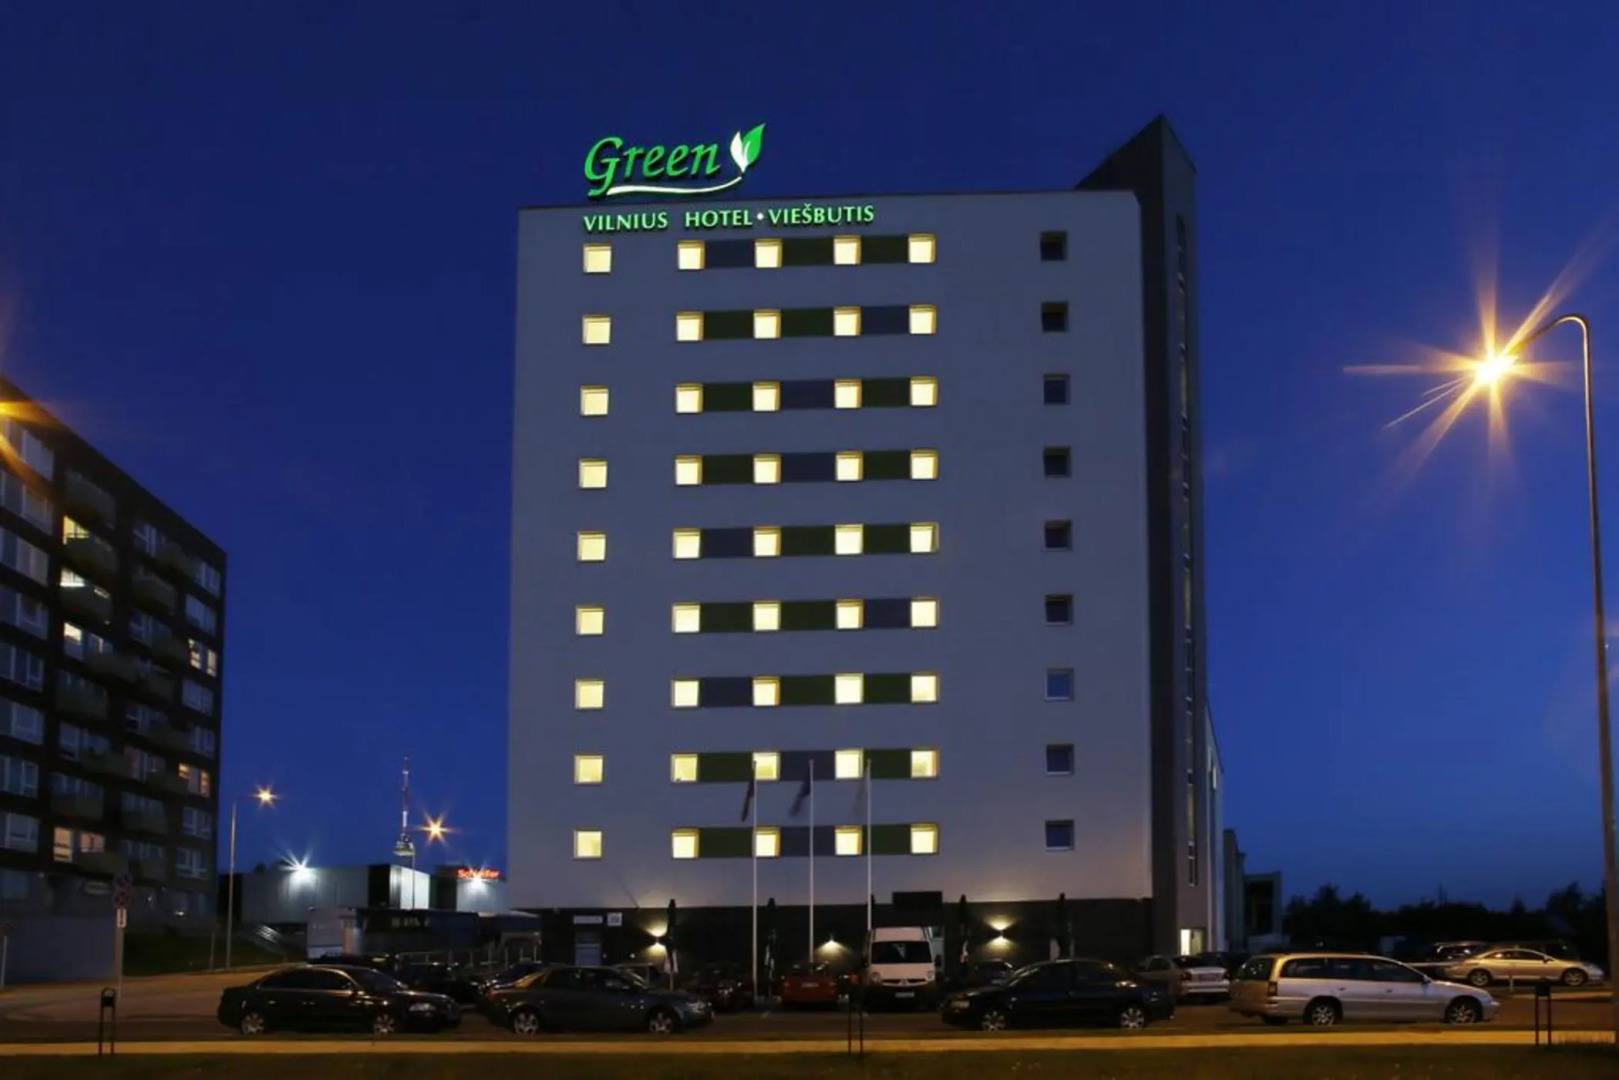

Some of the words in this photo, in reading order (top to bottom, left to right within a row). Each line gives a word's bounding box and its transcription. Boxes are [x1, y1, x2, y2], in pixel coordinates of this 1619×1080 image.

[584, 136, 722, 197] Green
[583, 211, 669, 232] VILNIUS
[685, 208, 752, 228] HOTEL
[768, 203, 875, 225] VIEŠBUTIS
